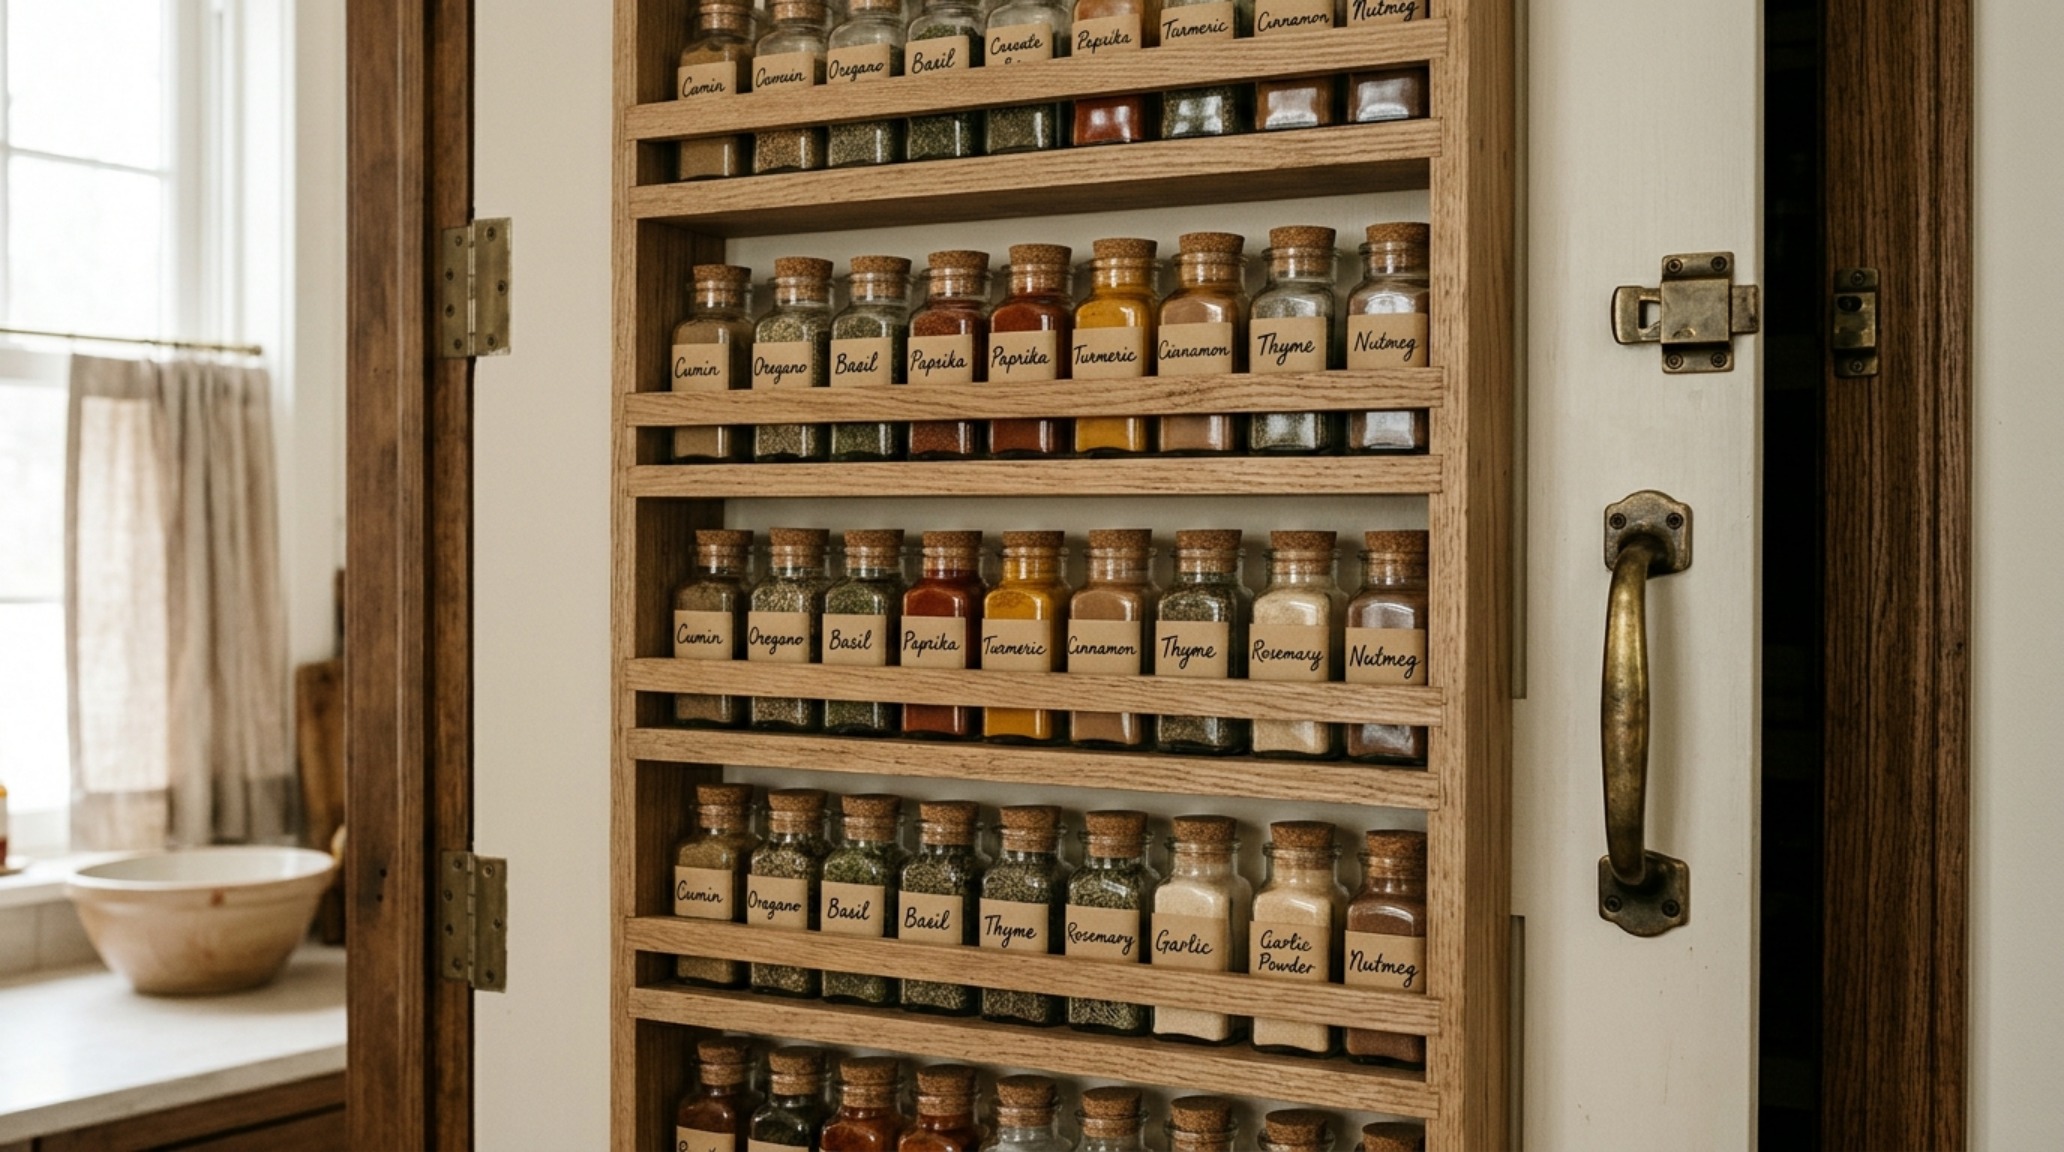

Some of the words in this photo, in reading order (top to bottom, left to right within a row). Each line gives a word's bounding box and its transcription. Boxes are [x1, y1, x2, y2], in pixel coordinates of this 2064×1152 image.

[1352, 0, 1421, 22] Nutmeg
[991, 345, 1050, 374] Paprika
[1074, 344, 1137, 365] Turmeric
[1257, 332, 1316, 366] Thyme
[1353, 330, 1420, 362] Nutmeg
[674, 356, 720, 379] Cumin
[754, 356, 808, 385] Oregano
[834, 351, 879, 375] Basil
[910, 349, 968, 377] Paprika
[676, 623, 724, 645] Cumin
[749, 626, 804, 655] Oregano
[828, 629, 872, 650] Basil
[903, 630, 960, 658] Paprika
[983, 635, 1047, 656] Turmeric
[1161, 635, 1217, 670] Thyme
[1251, 638, 1324, 672] Rosemary
[1349, 644, 1421, 680] Nutmeg
[676, 879, 724, 904] Cumin
[827, 897, 871, 921] Basil
[985, 914, 1037, 949] Thyme
[1068, 921, 1137, 956] Rosemary
[1155, 929, 1214, 955] Garlic
[1258, 952, 1316, 975] Powder
[1349, 949, 1420, 989] Nutmeg
